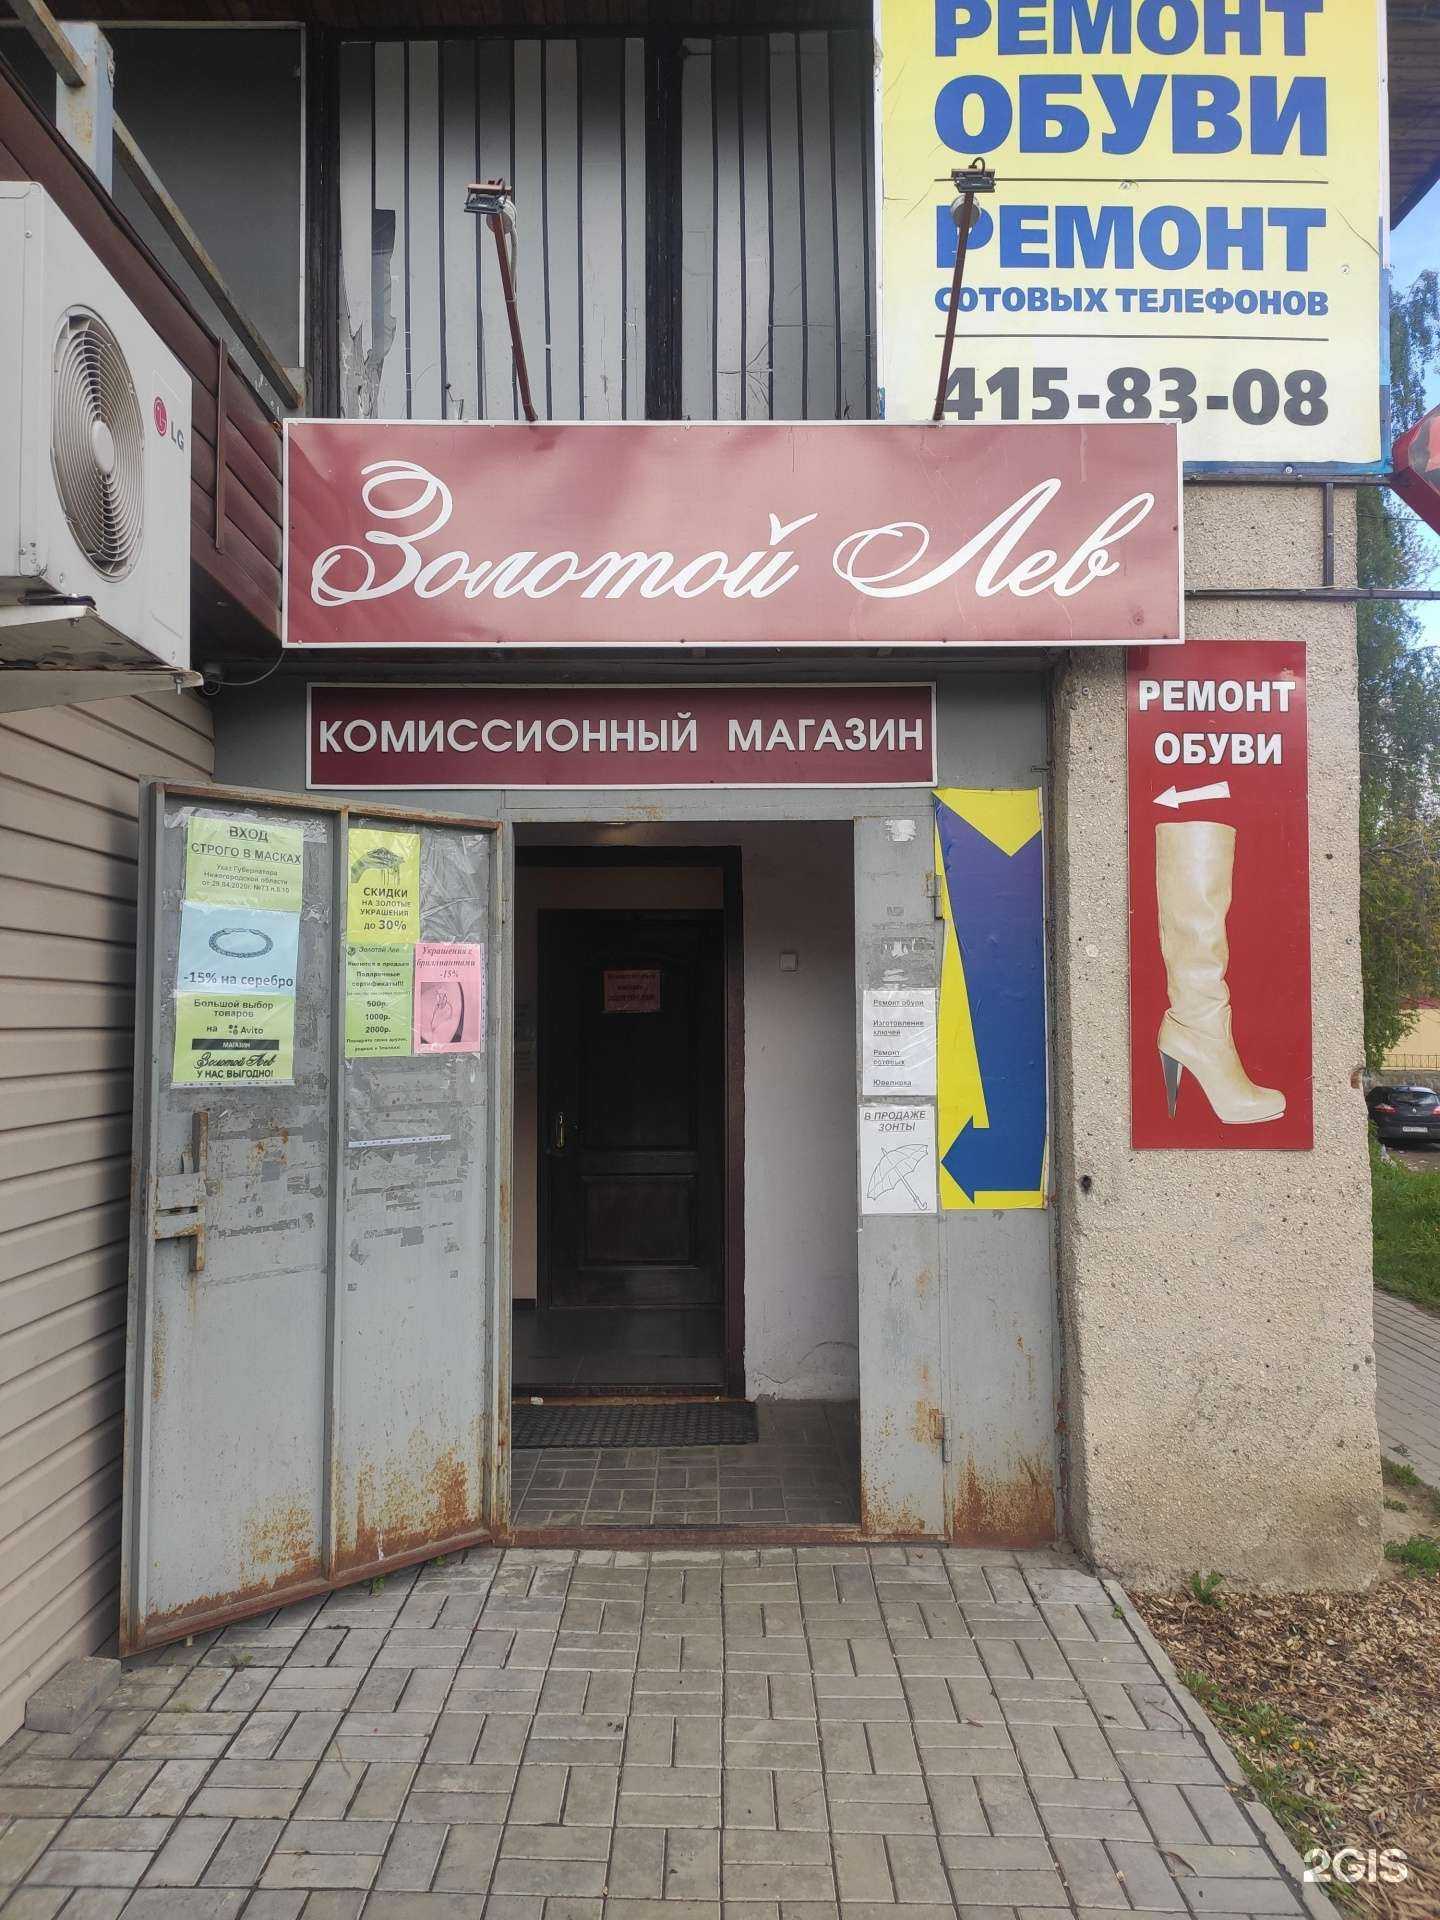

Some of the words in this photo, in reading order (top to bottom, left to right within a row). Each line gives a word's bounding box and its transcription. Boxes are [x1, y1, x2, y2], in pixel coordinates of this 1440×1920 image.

[935, 0, 1324, 56] РЕМОНТ
[935, 74, 1328, 156] ОБУВИ
[935, 204, 1327, 272] РЕМОНТ
[934, 287, 1107, 313] СОТОВЫХ
[1115, 288, 1329, 316] ТЕЛЕФОНОВ
[943, 366, 1329, 426] 415-83-08
[170, 421, 185, 451] LG
[310, 459, 818, 607] Золотой
[831, 477, 1156, 599] Лев
[1138, 680, 1297, 712] РЕМОНТ
[318, 711, 699, 754] КОМИССИОННЫЙ
[727, 717, 924, 753] МАГАЗИН
[1154, 732, 1283, 765] ОБУВИ
[229, 826, 269, 842] ВХОД
[191, 843, 240, 857] СТРОГО
[243, 849, 251, 858] В
[254, 850, 301, 864] МАСКАХ
[363, 888, 408, 898] СКИДКИ
[360, 908, 409, 917] УКРАШЕНИЯ
[363, 922, 375, 930] до
[378, 920, 407, 930] 30%
[422, 946, 465, 956] Украшения
[183, 972, 218, 984] -15%
[221, 975, 237, 985] на
[240, 975, 294, 989] серебро
[194, 999, 240, 1008] Большой
[242, 1001, 274, 1011] выбор
[214, 1010, 254, 1018] товаров
[240, 1026, 264, 1035] Avito
[196, 1070, 203, 1078] У
[204, 1070, 224, 1078] НАС
[226, 1070, 274, 1079] ВЫГОДНО!
[864, 1112, 871, 1121] В
[874, 1110, 926, 1121] ПРОДАЖЕ
[878, 1122, 916, 1132] ЗОНТЫ
